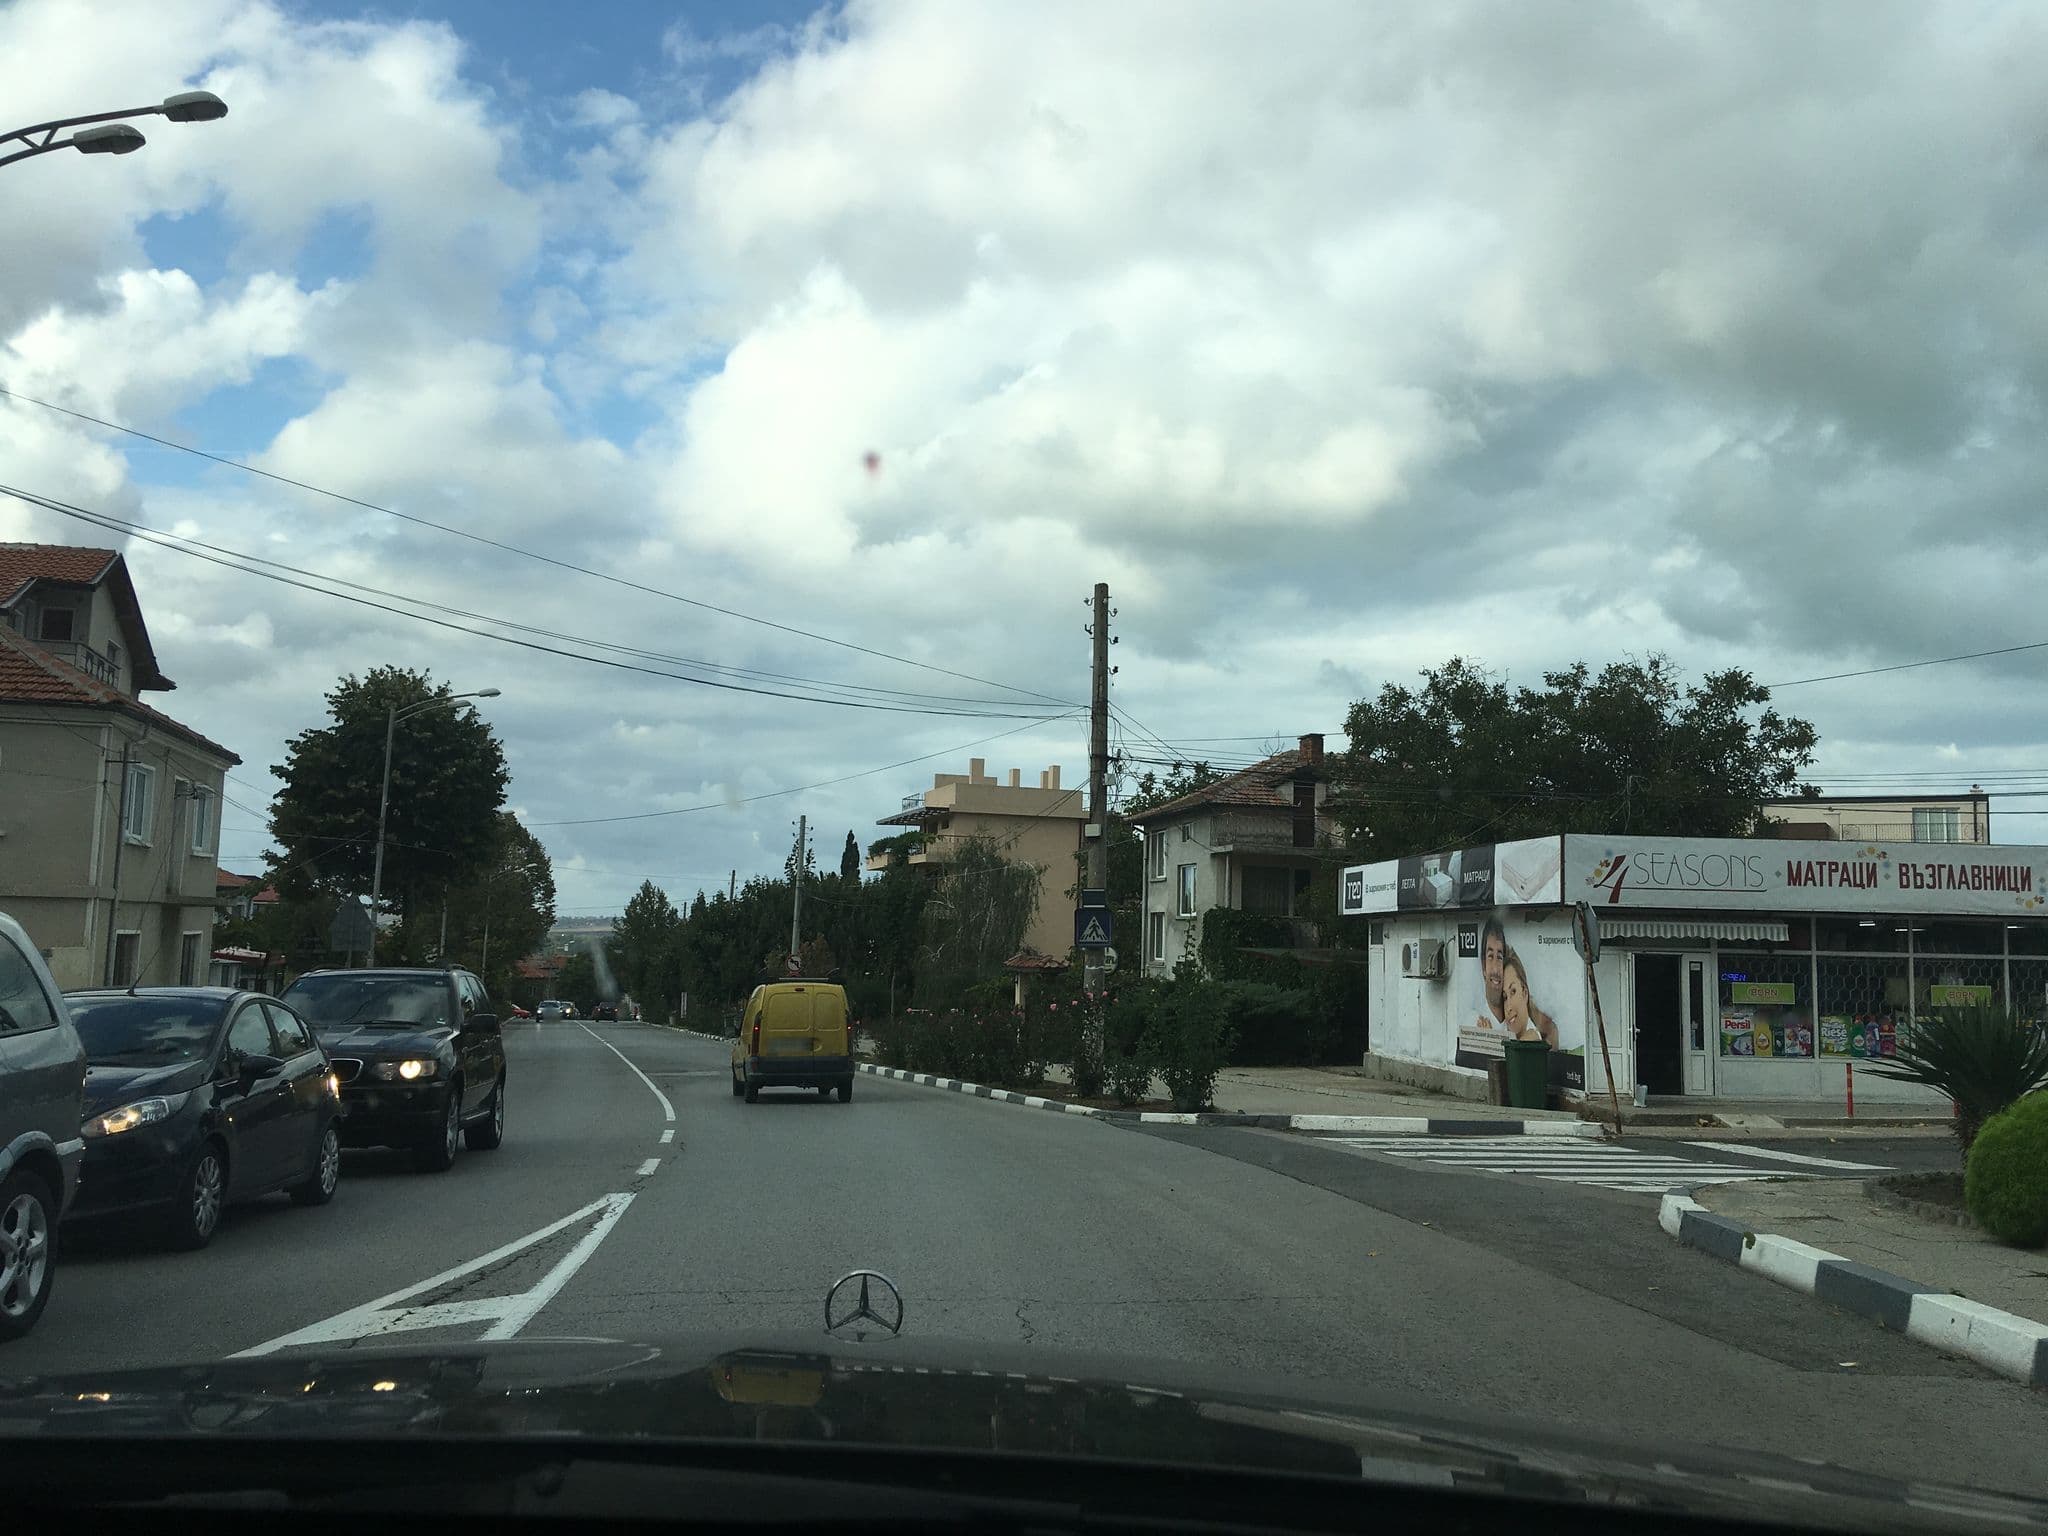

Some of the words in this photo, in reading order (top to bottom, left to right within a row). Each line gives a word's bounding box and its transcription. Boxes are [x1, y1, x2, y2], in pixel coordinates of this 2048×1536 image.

[1463, 870, 1491, 885] МАТРАЦИ
[1593, 855, 1630, 904] 4
[1633, 852, 1764, 888] SEASONS
[1786, 860, 1878, 890] МАТРАЦИ
[1899, 862, 2032, 893] ВЪЗГЛАВНИЦИ
[1721, 973, 1746, 982] OPEN
[1724, 1019, 1751, 1030] Persil
